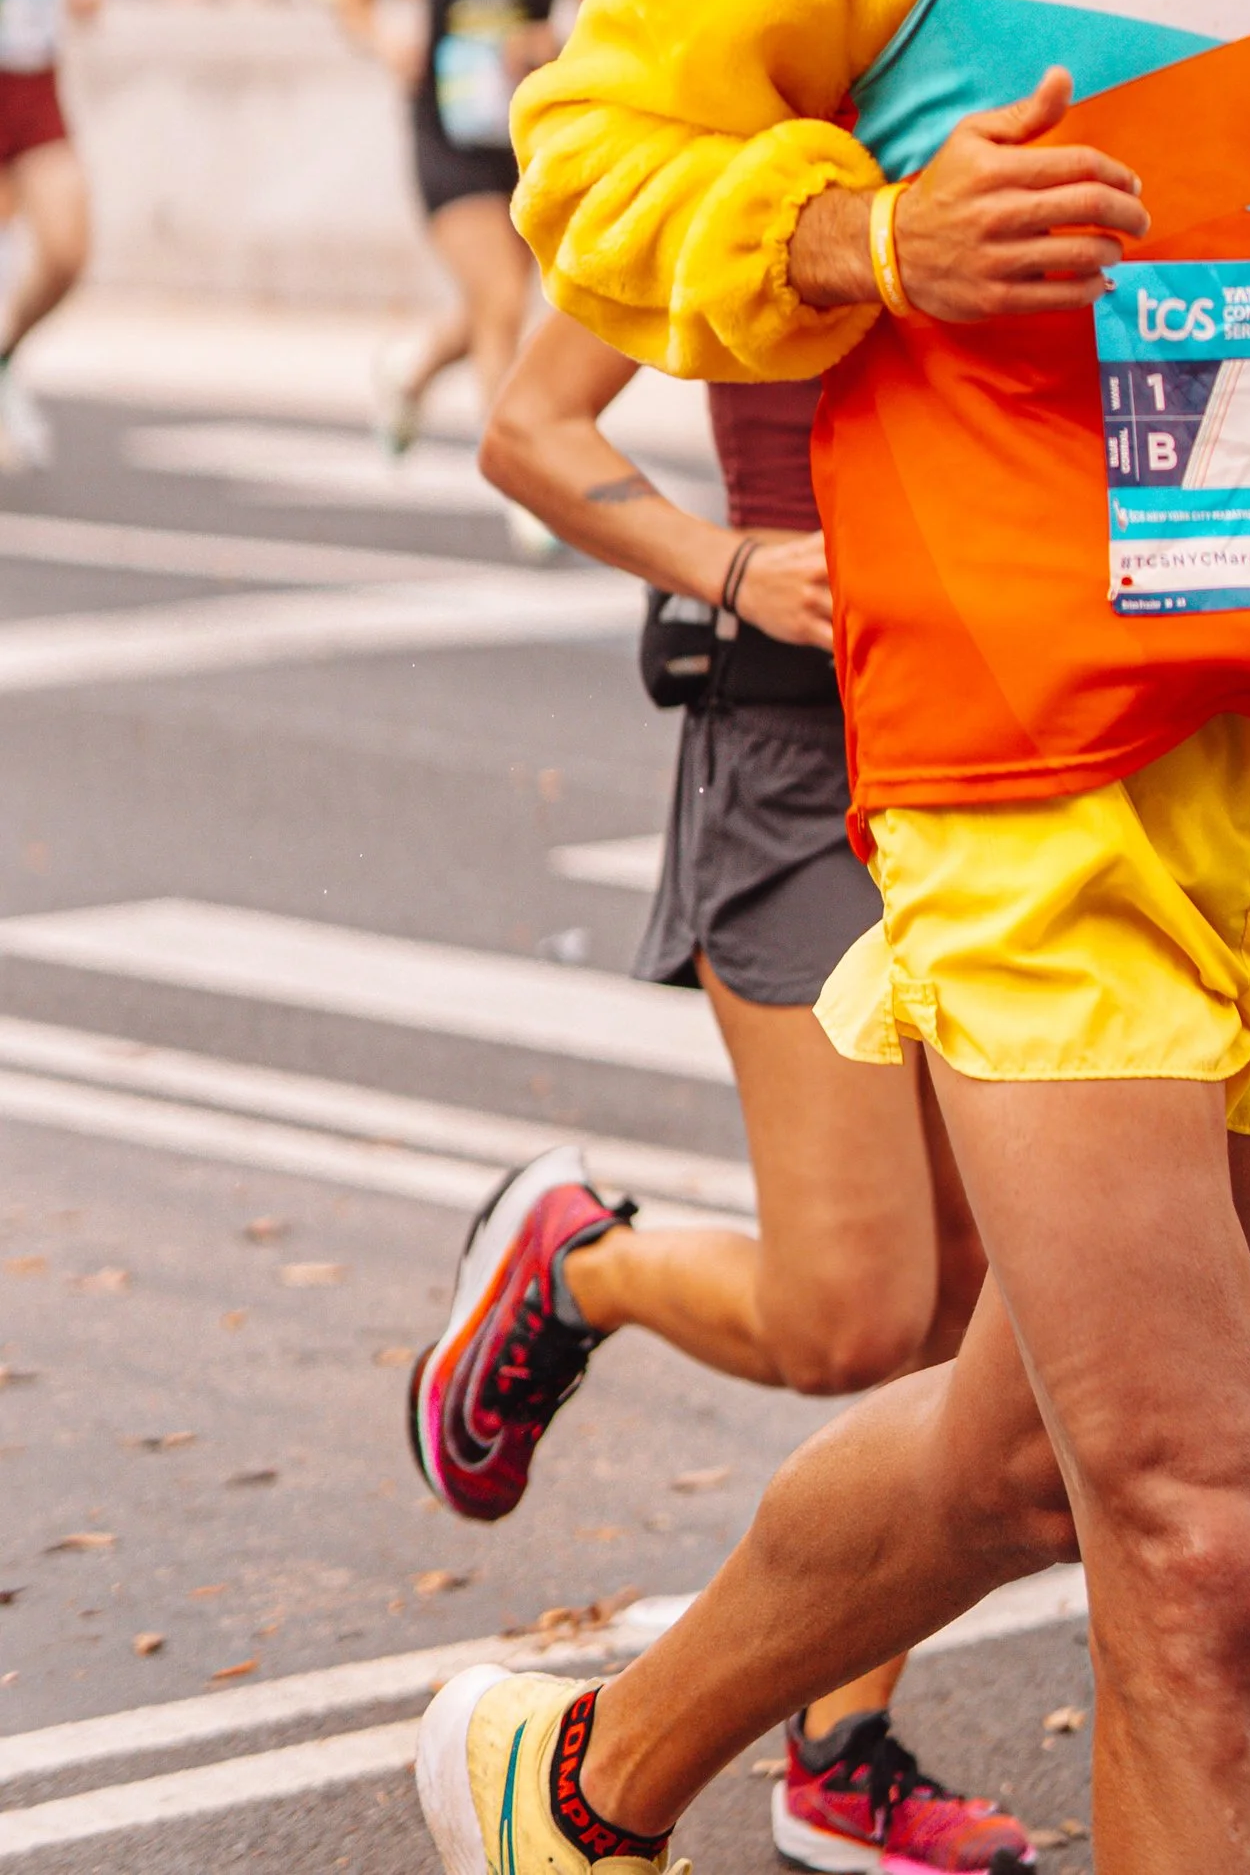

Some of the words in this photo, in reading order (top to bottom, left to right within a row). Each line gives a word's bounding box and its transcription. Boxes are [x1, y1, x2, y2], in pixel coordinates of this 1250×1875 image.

[1137, 287, 1216, 342] tcs
[1146, 373, 1165, 411] 1
[1148, 432, 1179, 471] B
